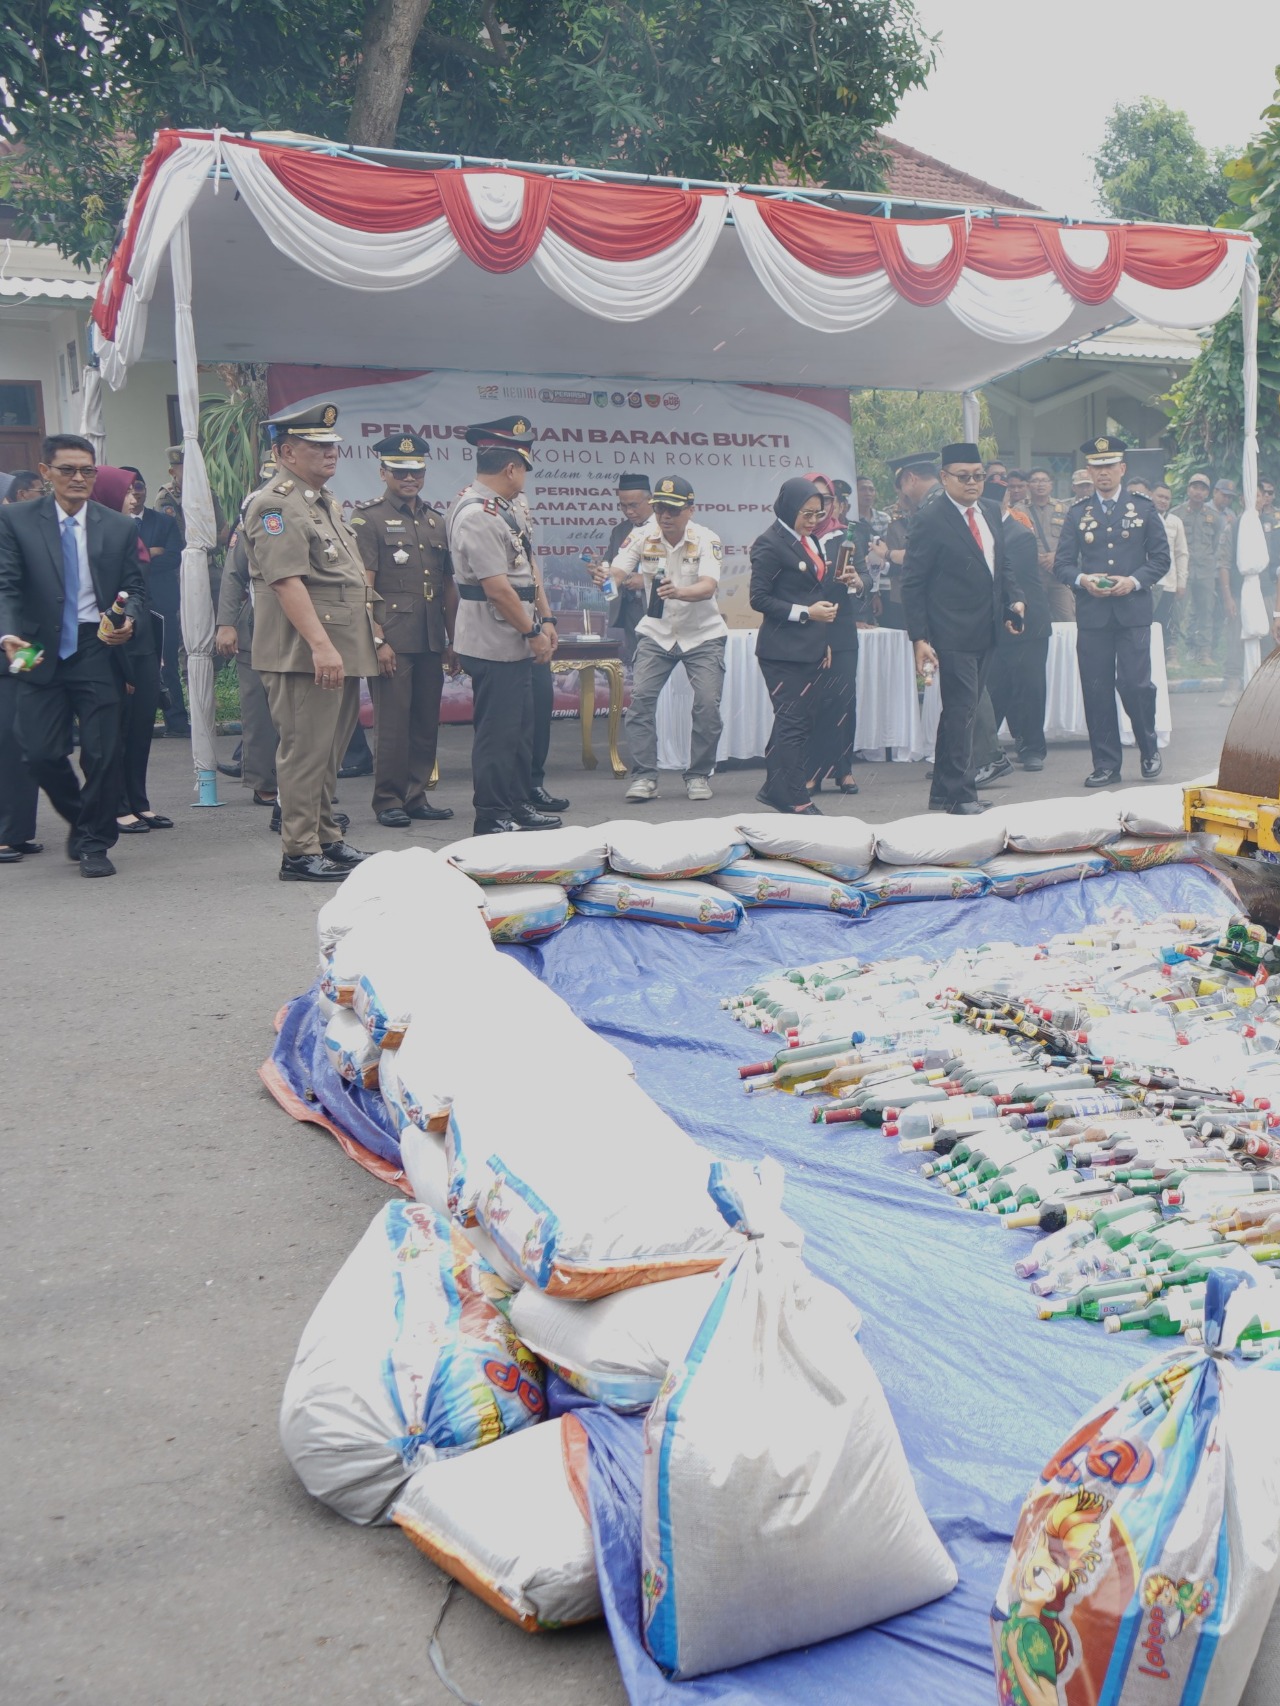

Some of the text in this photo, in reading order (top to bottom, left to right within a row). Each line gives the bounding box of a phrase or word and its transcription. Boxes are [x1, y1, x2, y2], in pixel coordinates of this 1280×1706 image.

[588, 428, 709, 446] BARANG
[713, 432, 790, 448] BUKTI
[614, 450, 655, 465] DAN
[666, 452, 733, 466] ROKOK
[742, 454, 814, 468] ILLEGAL
[534, 468, 581, 479] dalam
[738, 504, 758, 513] PP
[532, 517, 618, 526] ATLINMAS
[566, 528, 604, 539] serta
[1139, 1606, 1171, 1680] Lahap
